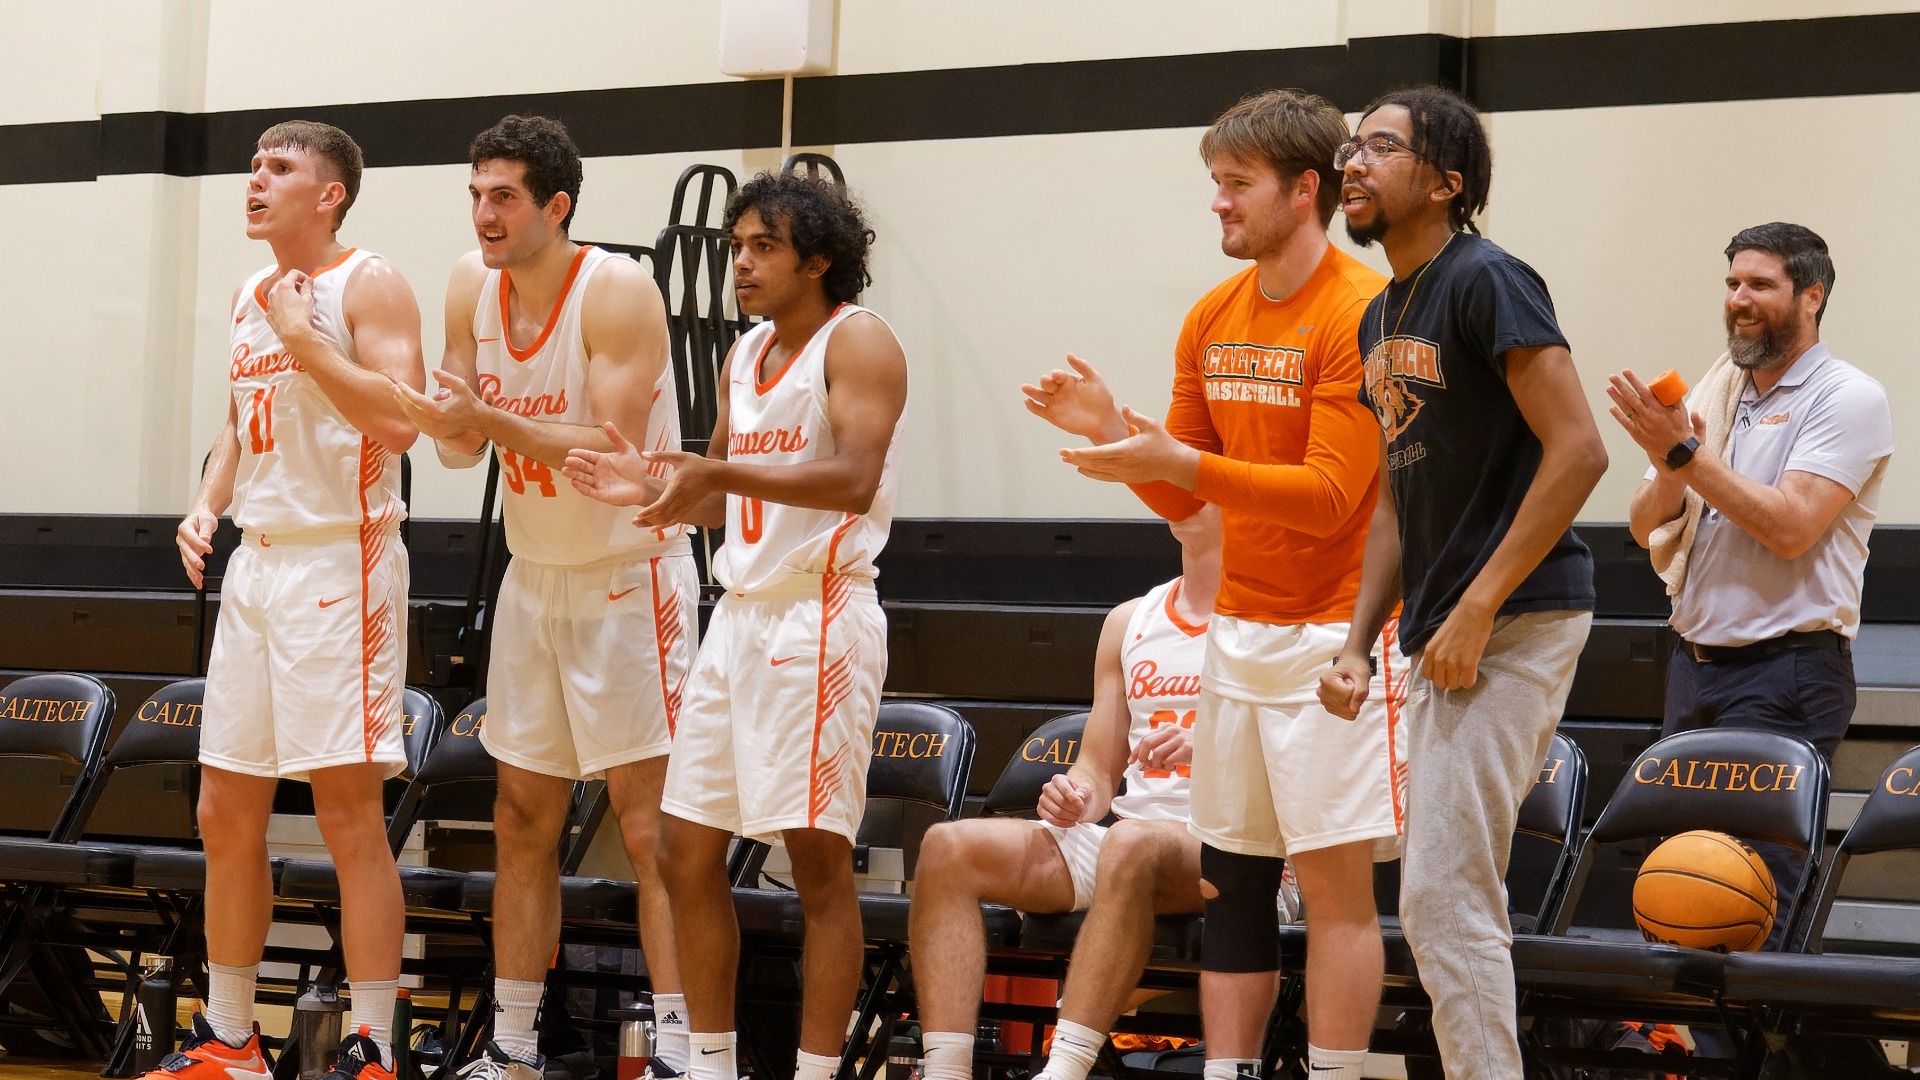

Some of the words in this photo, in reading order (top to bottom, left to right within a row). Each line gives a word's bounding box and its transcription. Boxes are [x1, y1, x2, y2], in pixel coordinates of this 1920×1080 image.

[1204, 345, 1302, 383] CALTECH
[1205, 381, 1301, 408] BASKETBALL
[249, 385, 274, 455] 11
[499, 443, 561, 497] 34
[138, 701, 204, 727] CALT
[872, 731, 952, 758] TECH
[1634, 757, 1805, 792] CALTECH
